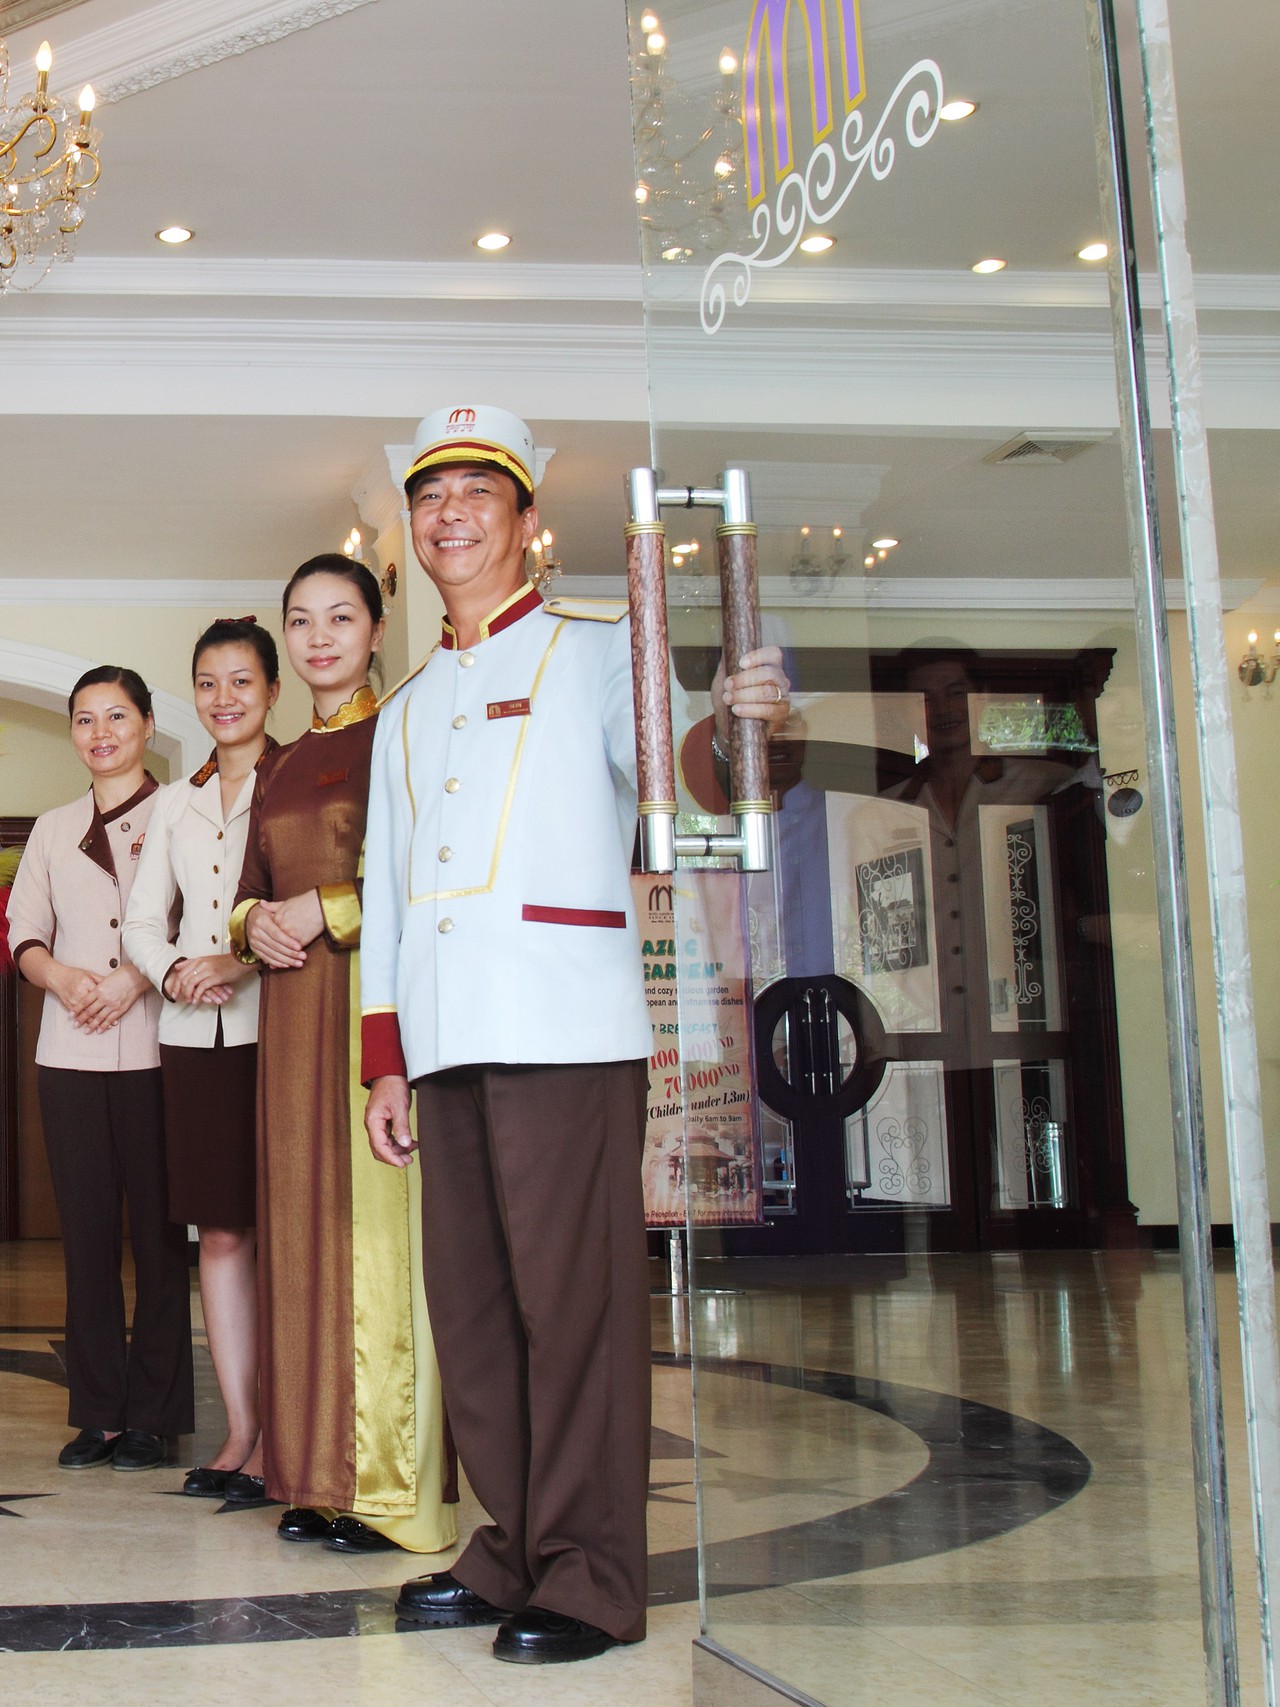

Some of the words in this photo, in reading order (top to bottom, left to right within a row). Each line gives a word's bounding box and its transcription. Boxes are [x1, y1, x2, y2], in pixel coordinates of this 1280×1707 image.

[642, 939, 698, 957] AZIG
[658, 987, 674, 996] cozy
[706, 986, 728, 996] garden
[721, 997, 743, 1005] dishes
[660, 1023, 717, 1034] BREKFAST
[691, 1096, 720, 1110] under
